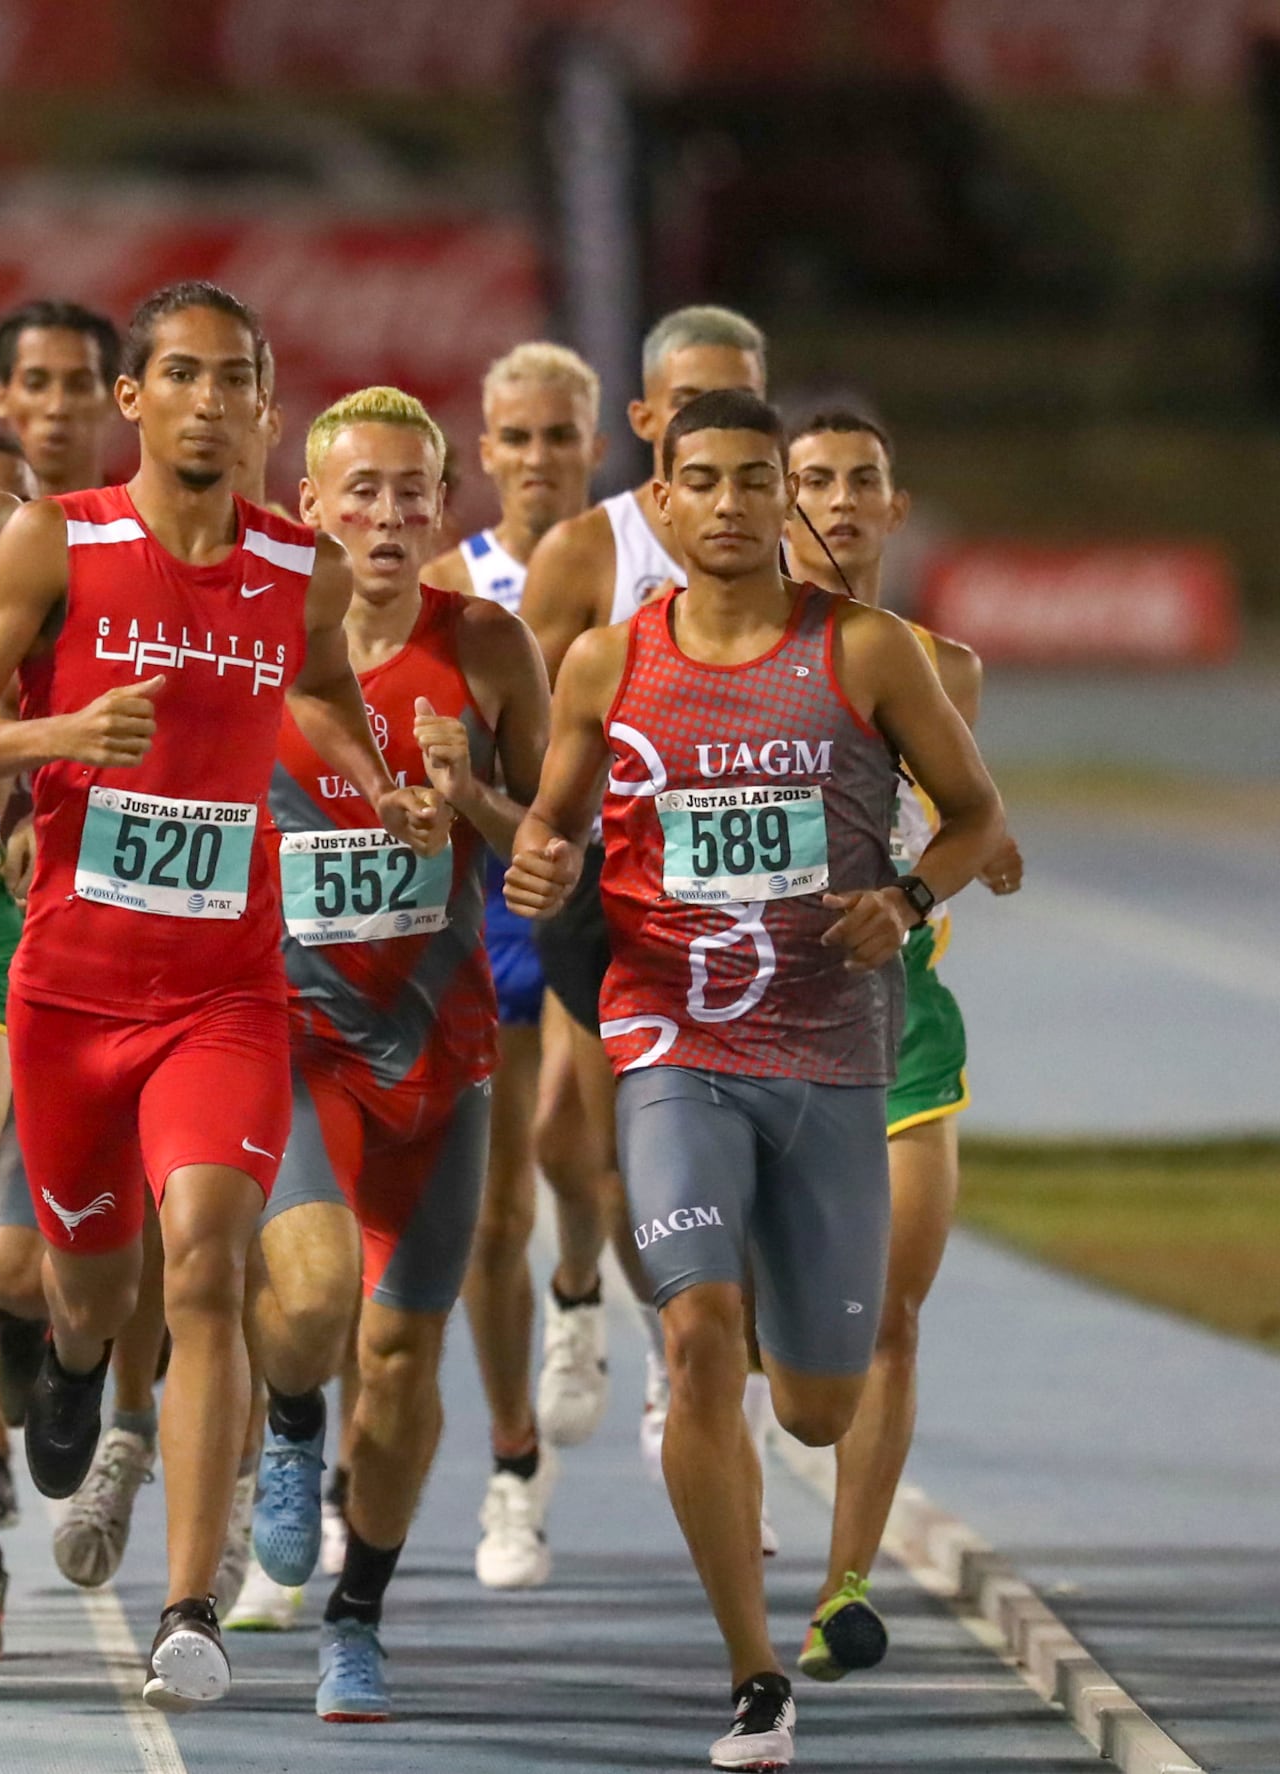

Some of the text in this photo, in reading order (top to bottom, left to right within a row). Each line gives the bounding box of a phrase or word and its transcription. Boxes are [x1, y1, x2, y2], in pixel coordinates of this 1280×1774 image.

[98, 617, 285, 664] GALLITOS
[695, 740, 834, 778] UAGM
[121, 797, 248, 823] JUSTAS LAI 2019
[687, 794, 737, 808] JUSTAS
[741, 792, 769, 805] LAI
[113, 814, 223, 890] 520
[311, 835, 366, 850] JUSTAS
[690, 806, 792, 878] 589
[315, 847, 418, 917] 552
[791, 875, 814, 887] AT&T
[208, 900, 232, 910] AT&T
[414, 914, 438, 925] AT&T
[634, 1205, 724, 1251] UAGM
